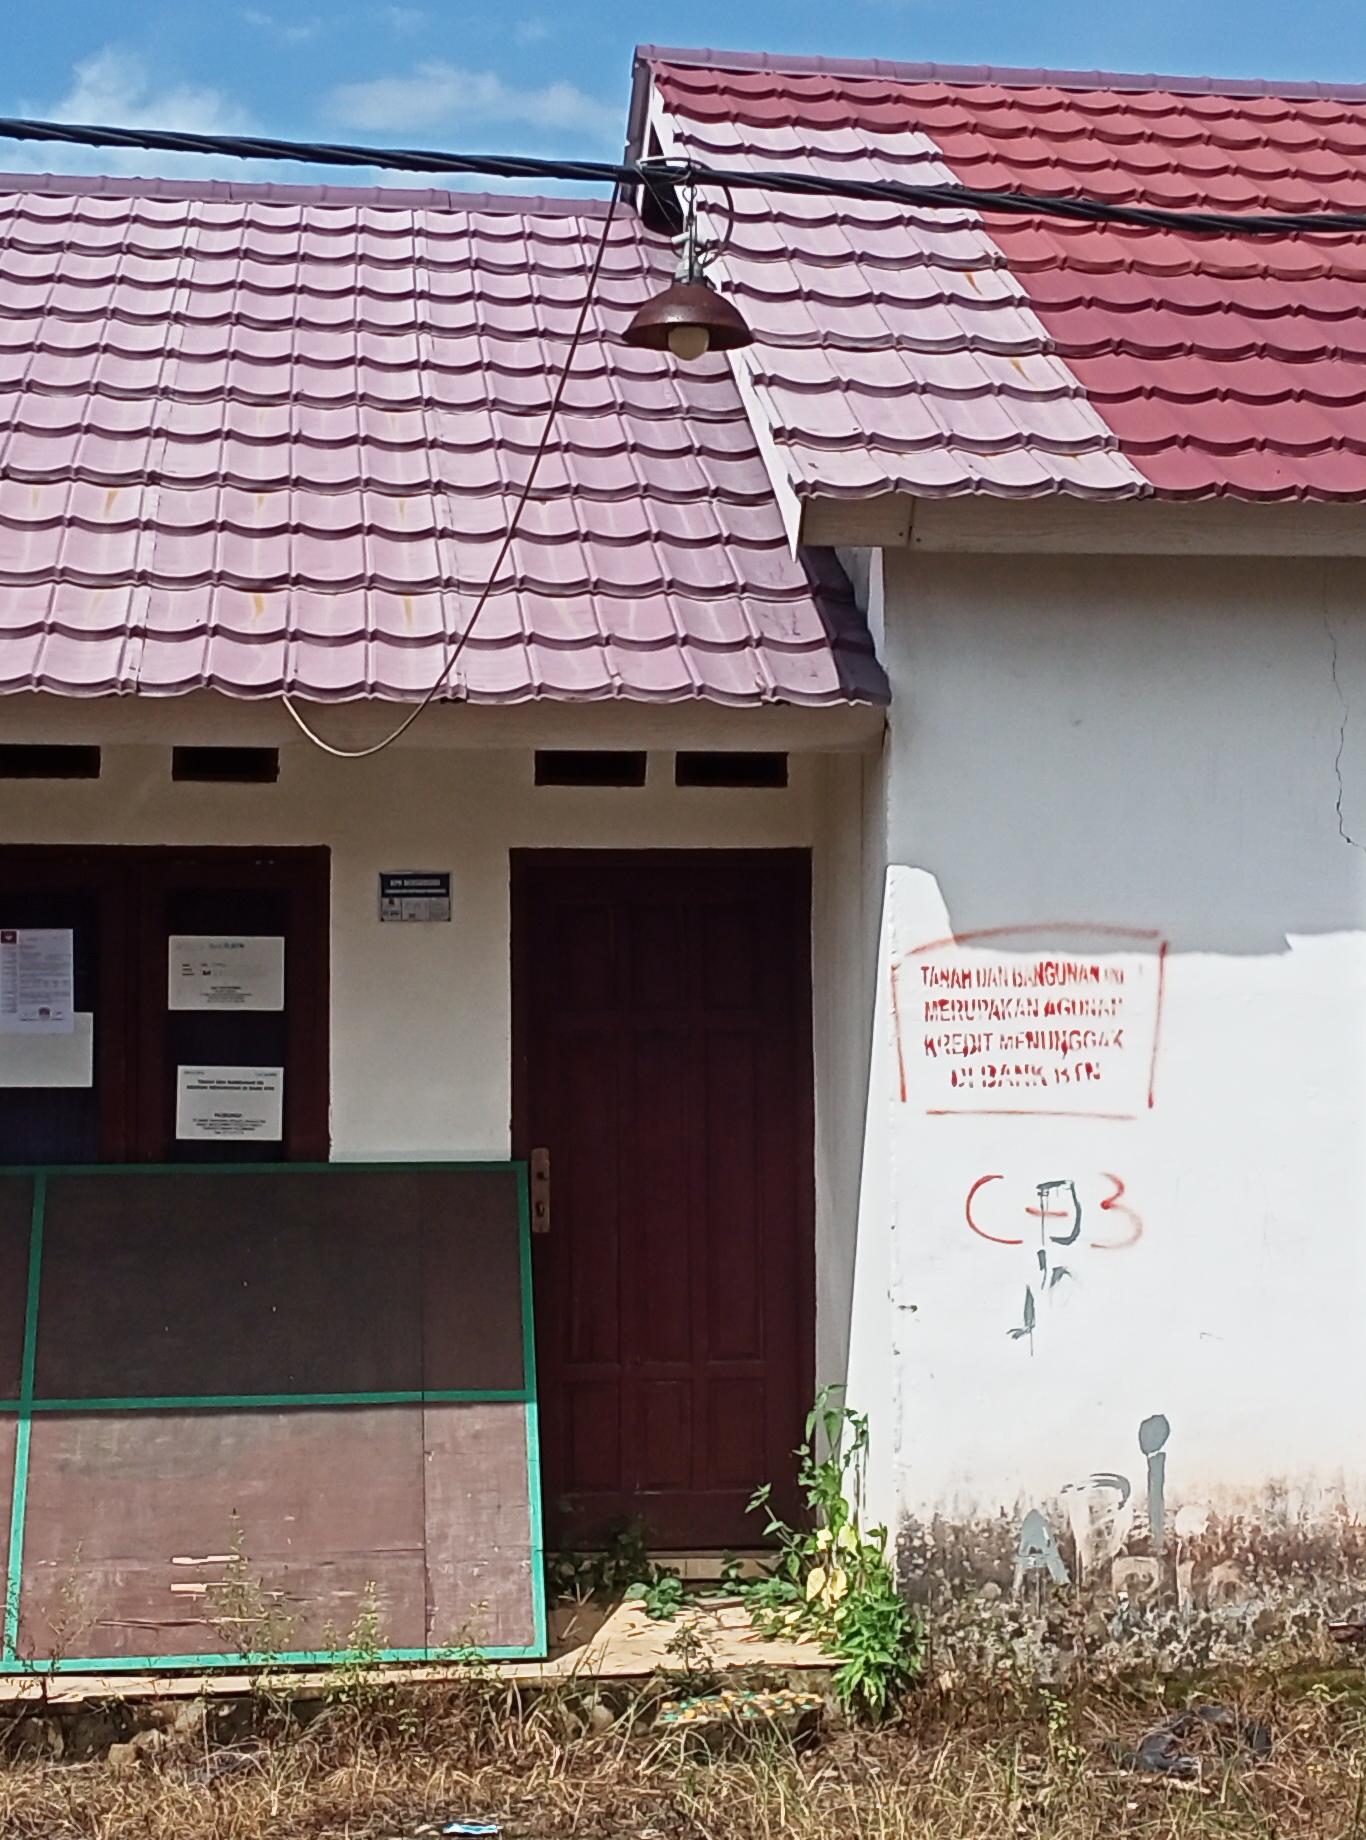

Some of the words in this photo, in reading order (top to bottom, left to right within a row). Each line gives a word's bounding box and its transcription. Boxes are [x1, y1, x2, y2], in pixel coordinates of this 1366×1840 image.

[920, 965, 972, 989] TANAH
[976, 965, 1009, 988] DAN
[1012, 960, 1100, 988] BANGUNAN
[924, 998, 1038, 1022] MERUPAKAN
[924, 1032, 993, 1058] KREDIT
[999, 1029, 1123, 1056] MENUNGGAK
[951, 1067, 974, 1088] DI
[981, 1063, 1048, 1089] BANK
